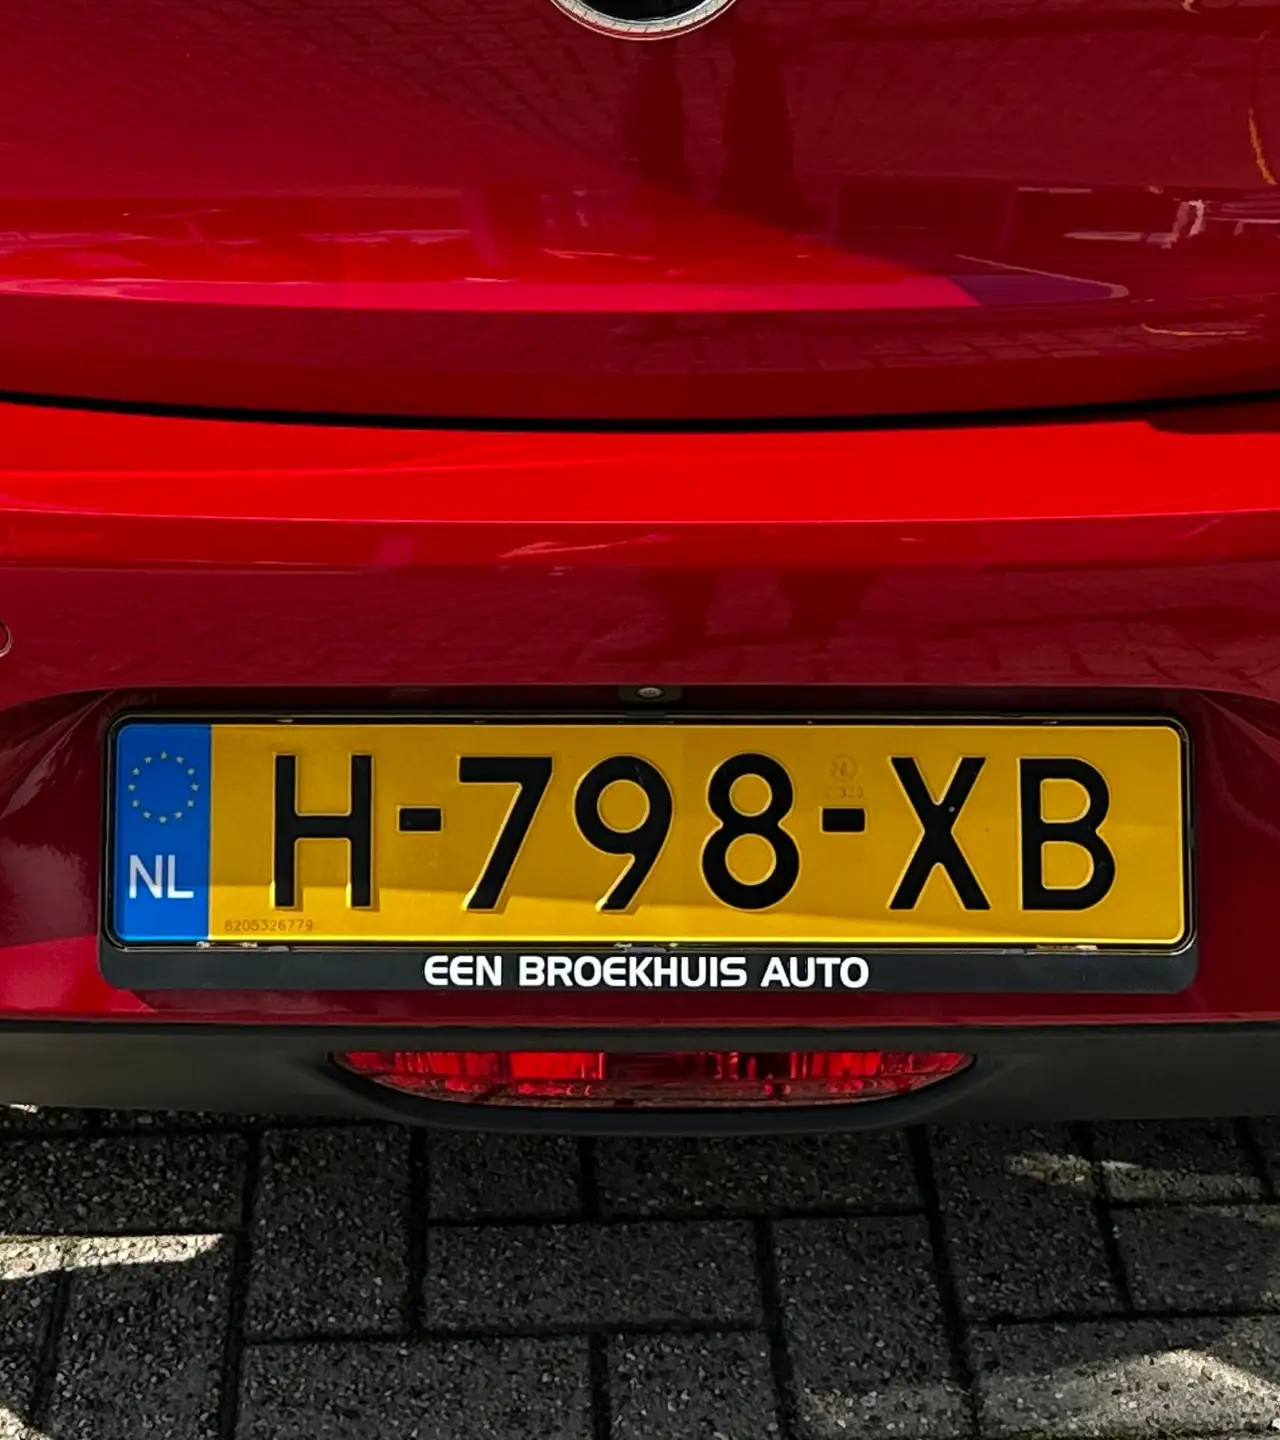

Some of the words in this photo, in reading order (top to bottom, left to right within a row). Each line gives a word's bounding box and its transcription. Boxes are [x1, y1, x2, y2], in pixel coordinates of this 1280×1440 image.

[271, 752, 1118, 912] H-798-XB
[129, 854, 195, 900] NL
[423, 954, 502, 986] EEN
[518, 954, 748, 988] BROEKHUIS
[760, 956, 870, 989] AUTO
